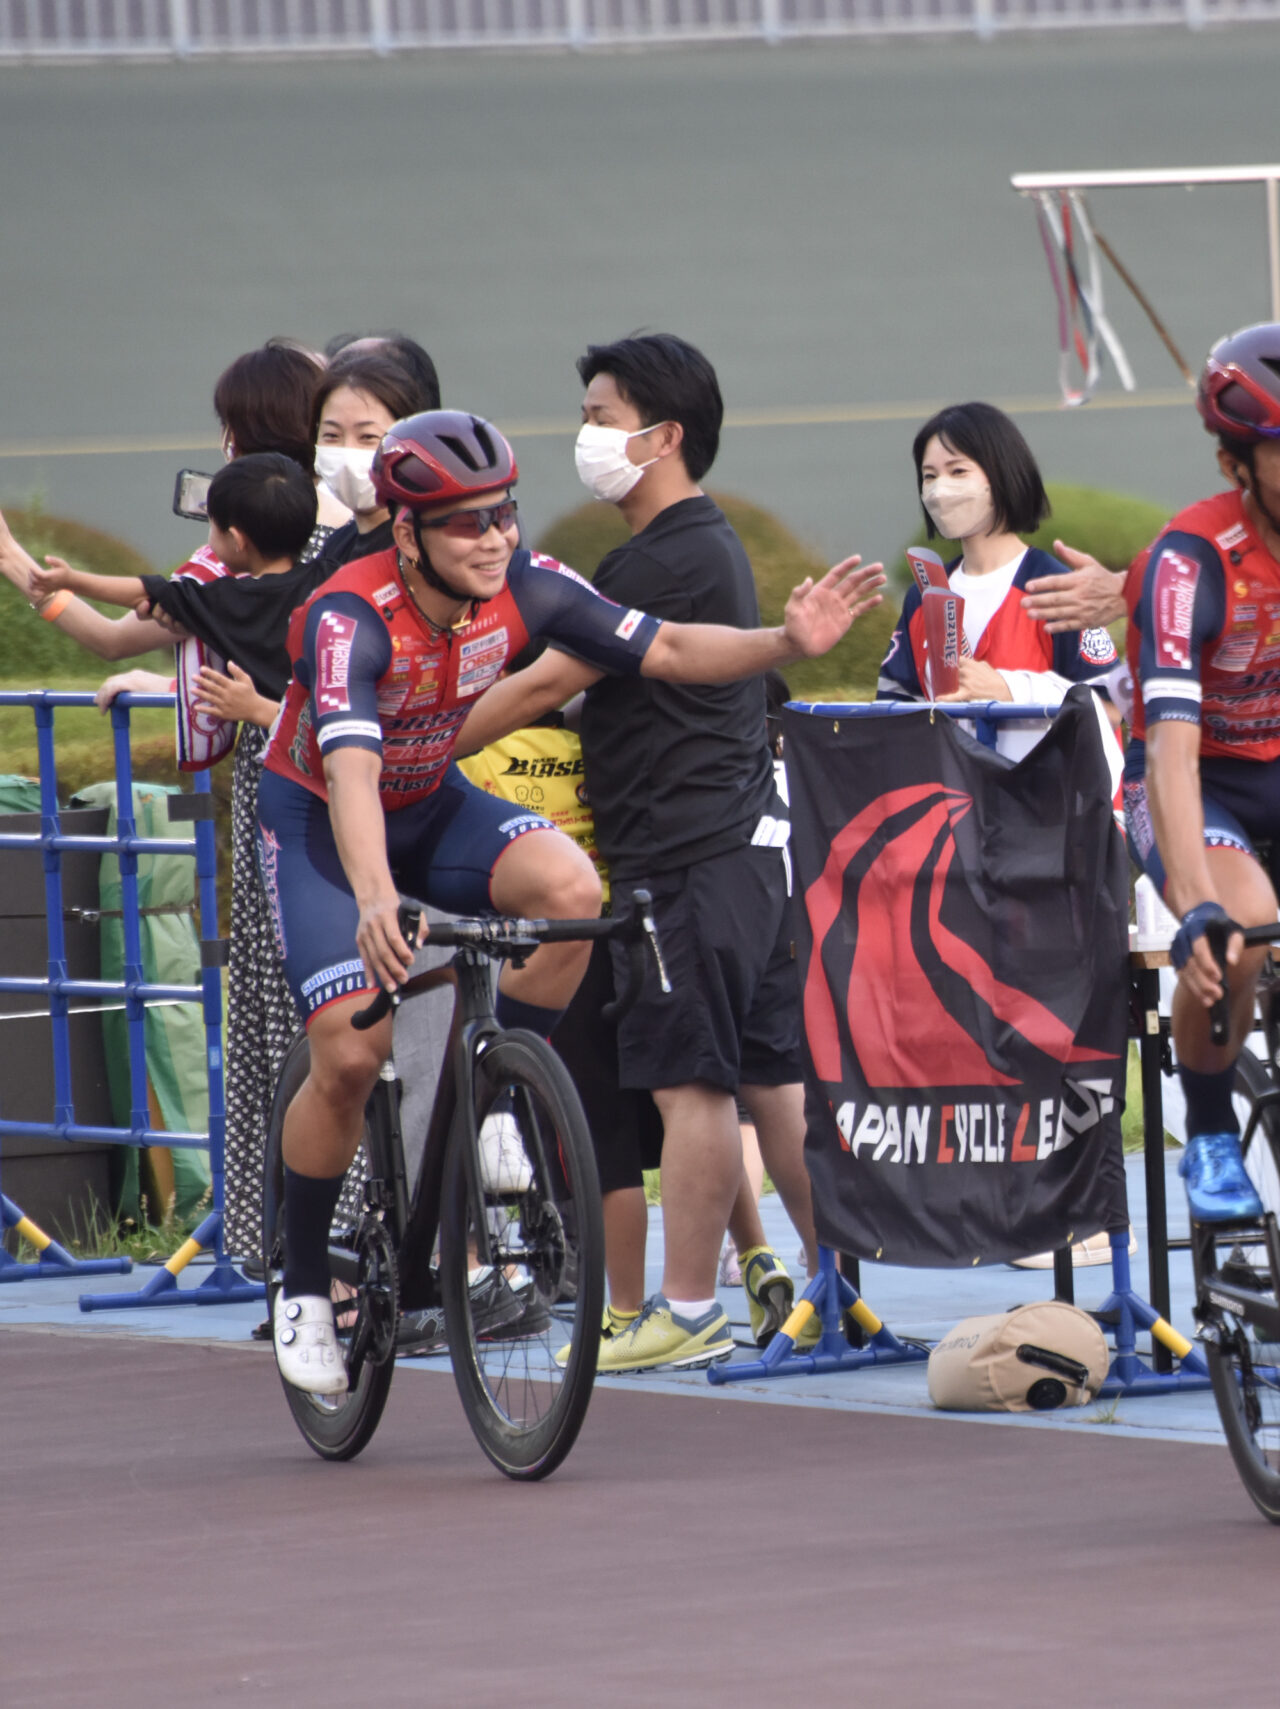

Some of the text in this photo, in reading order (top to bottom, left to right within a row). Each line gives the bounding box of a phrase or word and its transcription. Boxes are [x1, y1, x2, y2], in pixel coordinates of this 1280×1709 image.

[944, 599, 957, 667] Blitzen
[1169, 575, 1195, 639] kanseki
[326, 638, 352, 689] kanseki
[309, 975, 363, 1011] SUNVOL
[829, 1100, 931, 1164] APAN
[937, 1103, 1006, 1164] CYCLE
